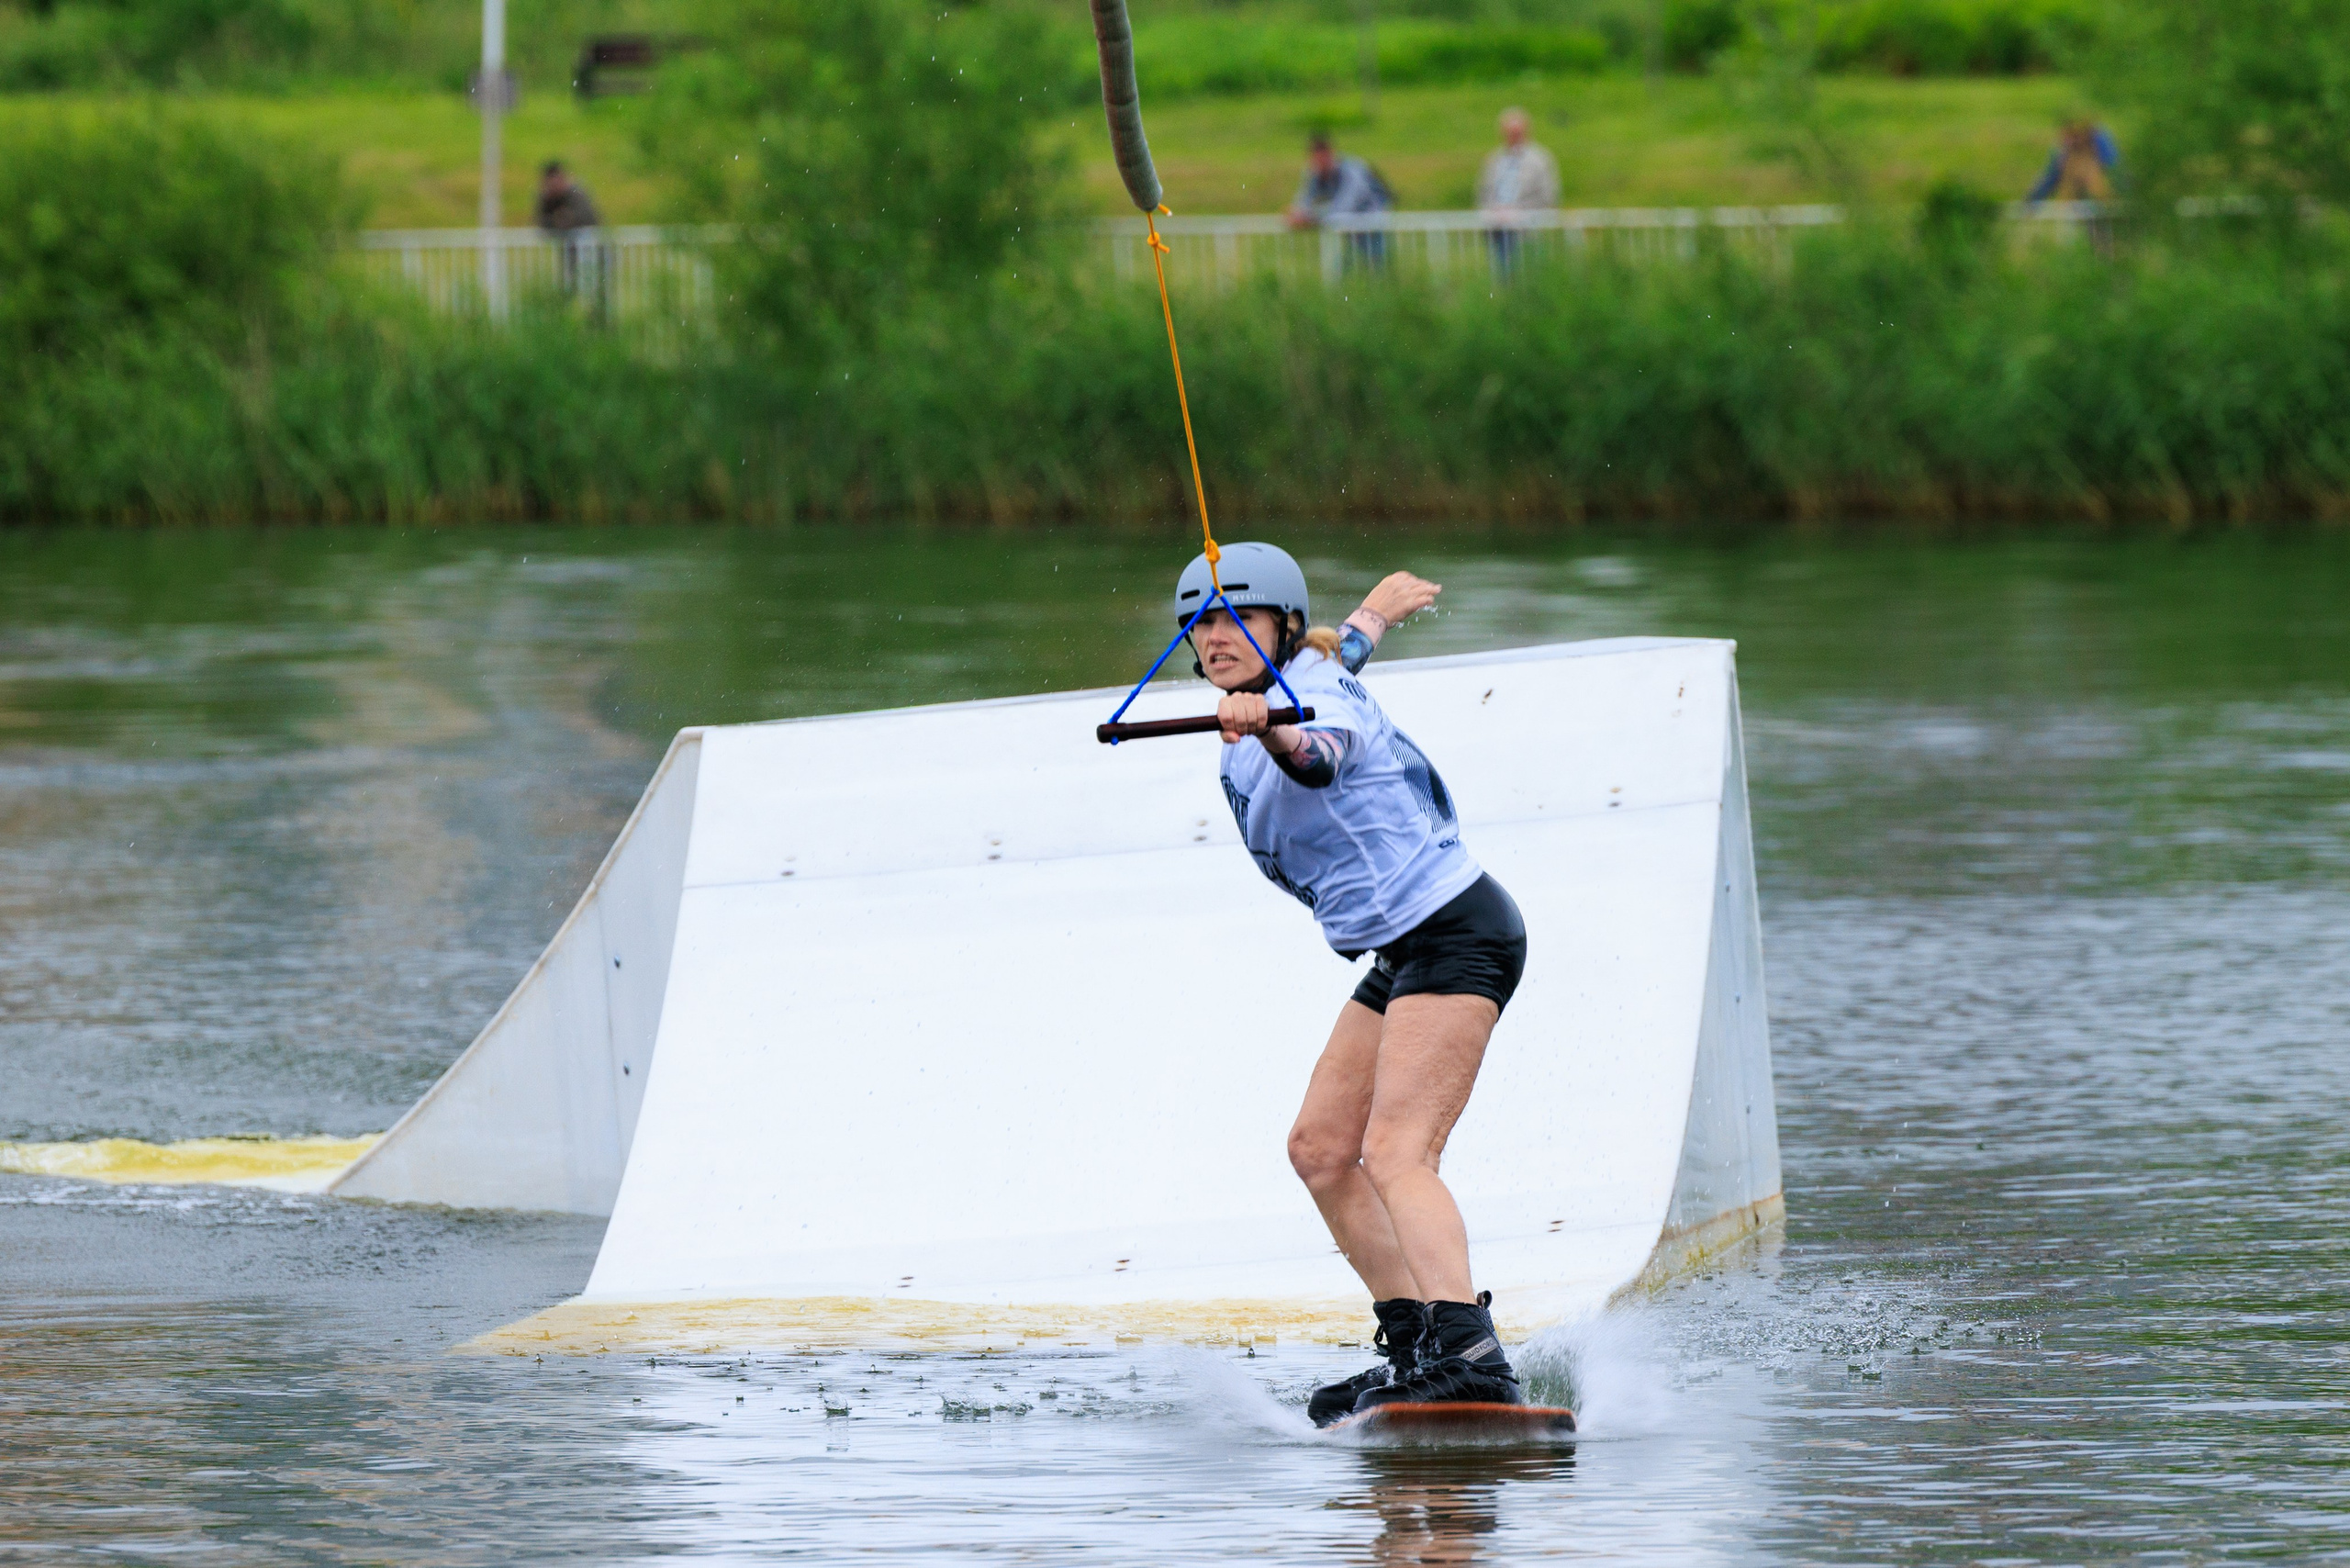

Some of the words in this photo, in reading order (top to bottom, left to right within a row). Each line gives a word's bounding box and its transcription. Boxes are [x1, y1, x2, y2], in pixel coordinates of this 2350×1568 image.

[1232, 593, 1266, 602] MYSTIC
[1460, 1347, 1481, 1360] IQUID
[1479, 1339, 1496, 1351] FORC
